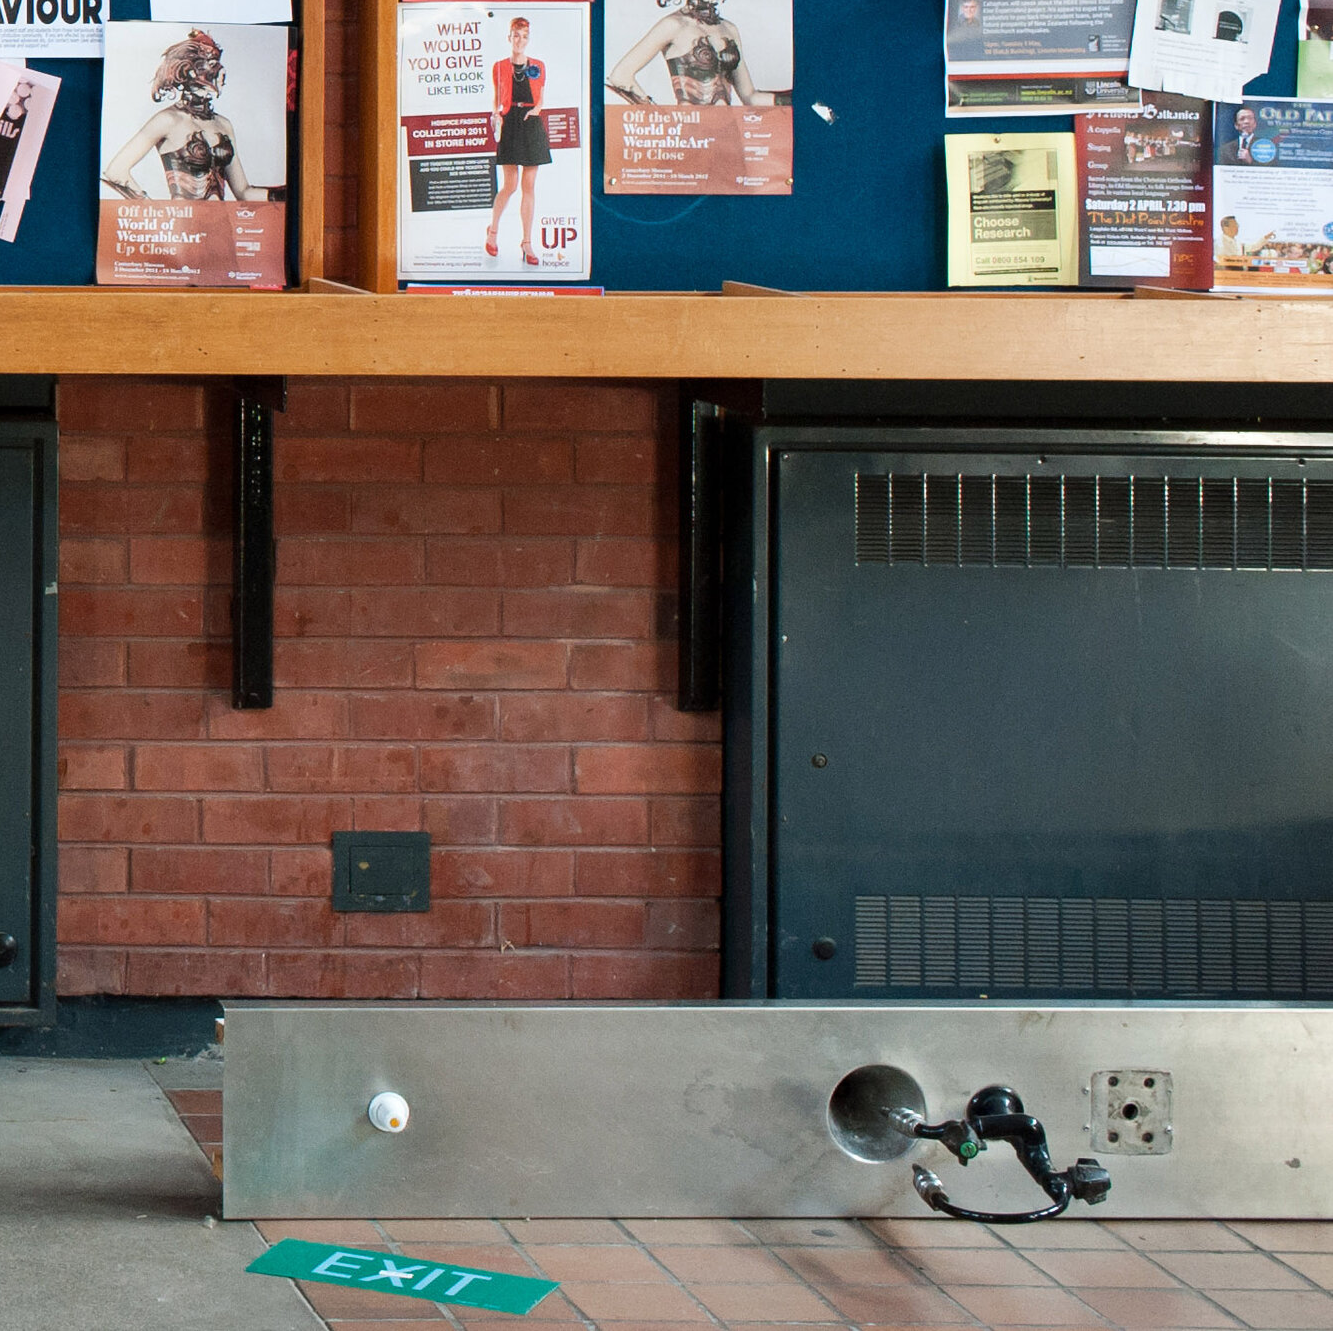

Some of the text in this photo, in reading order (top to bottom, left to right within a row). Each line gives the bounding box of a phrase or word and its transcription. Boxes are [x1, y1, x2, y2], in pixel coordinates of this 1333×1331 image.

[437, 21, 481, 36] WHAT
[423, 38, 482, 53] WOULD
[407, 54, 483, 71] YOU GIVE
[418, 70, 484, 84] FOR A LOOK
[427, 83, 485, 96] LIKE THIS?
[622, 110, 700, 124] Off the Wall
[622, 123, 683, 136] World of
[622, 148, 685, 163] Up Close
[973, 216, 1020, 229] Choose
[974, 227, 1031, 240] Research
[311, 1251, 492, 1296] EXIT
